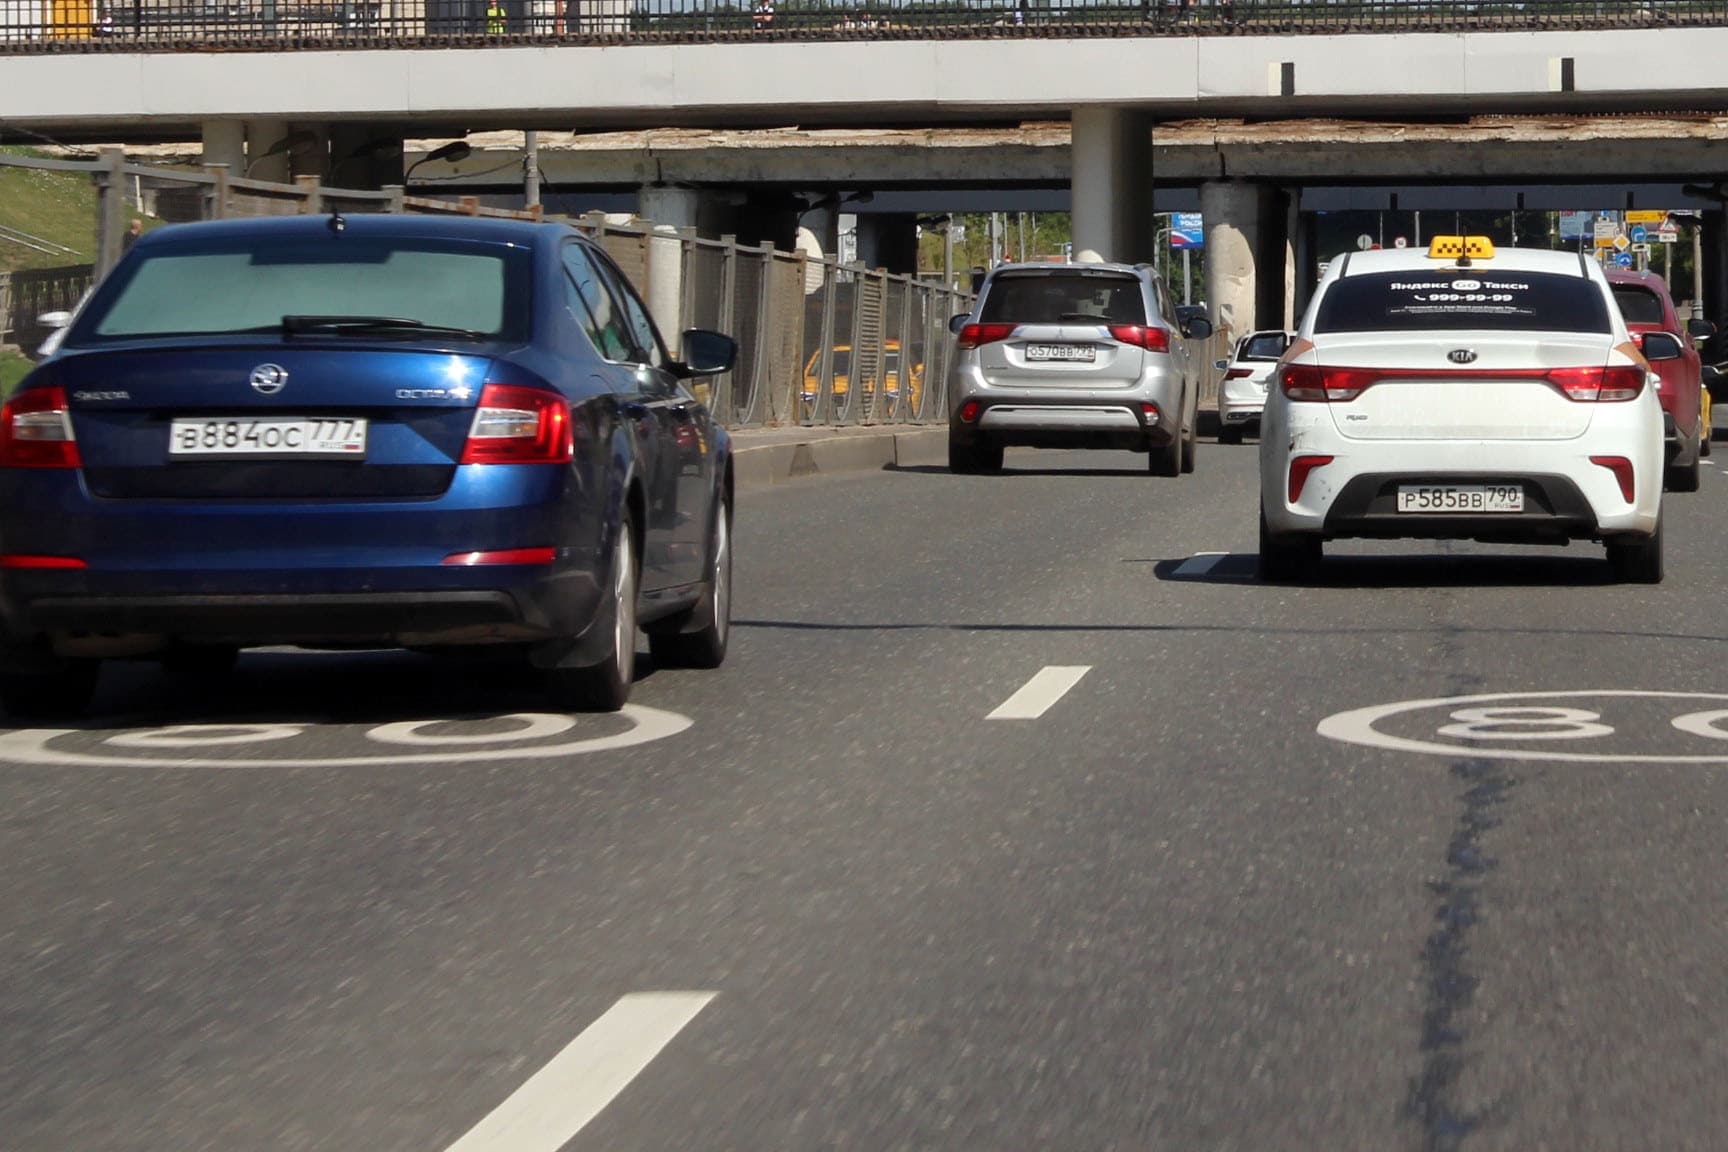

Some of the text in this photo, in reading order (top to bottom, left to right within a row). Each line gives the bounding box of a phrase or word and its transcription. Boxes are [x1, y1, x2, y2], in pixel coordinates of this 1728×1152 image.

[1390, 282, 1449, 290] Яндекс
[1483, 281, 1529, 290] Такси
[1452, 351, 1473, 361] KIA
[181, 419, 355, 449] В884ОС 777
[1405, 487, 1518, 508] Р585ВВ 790
